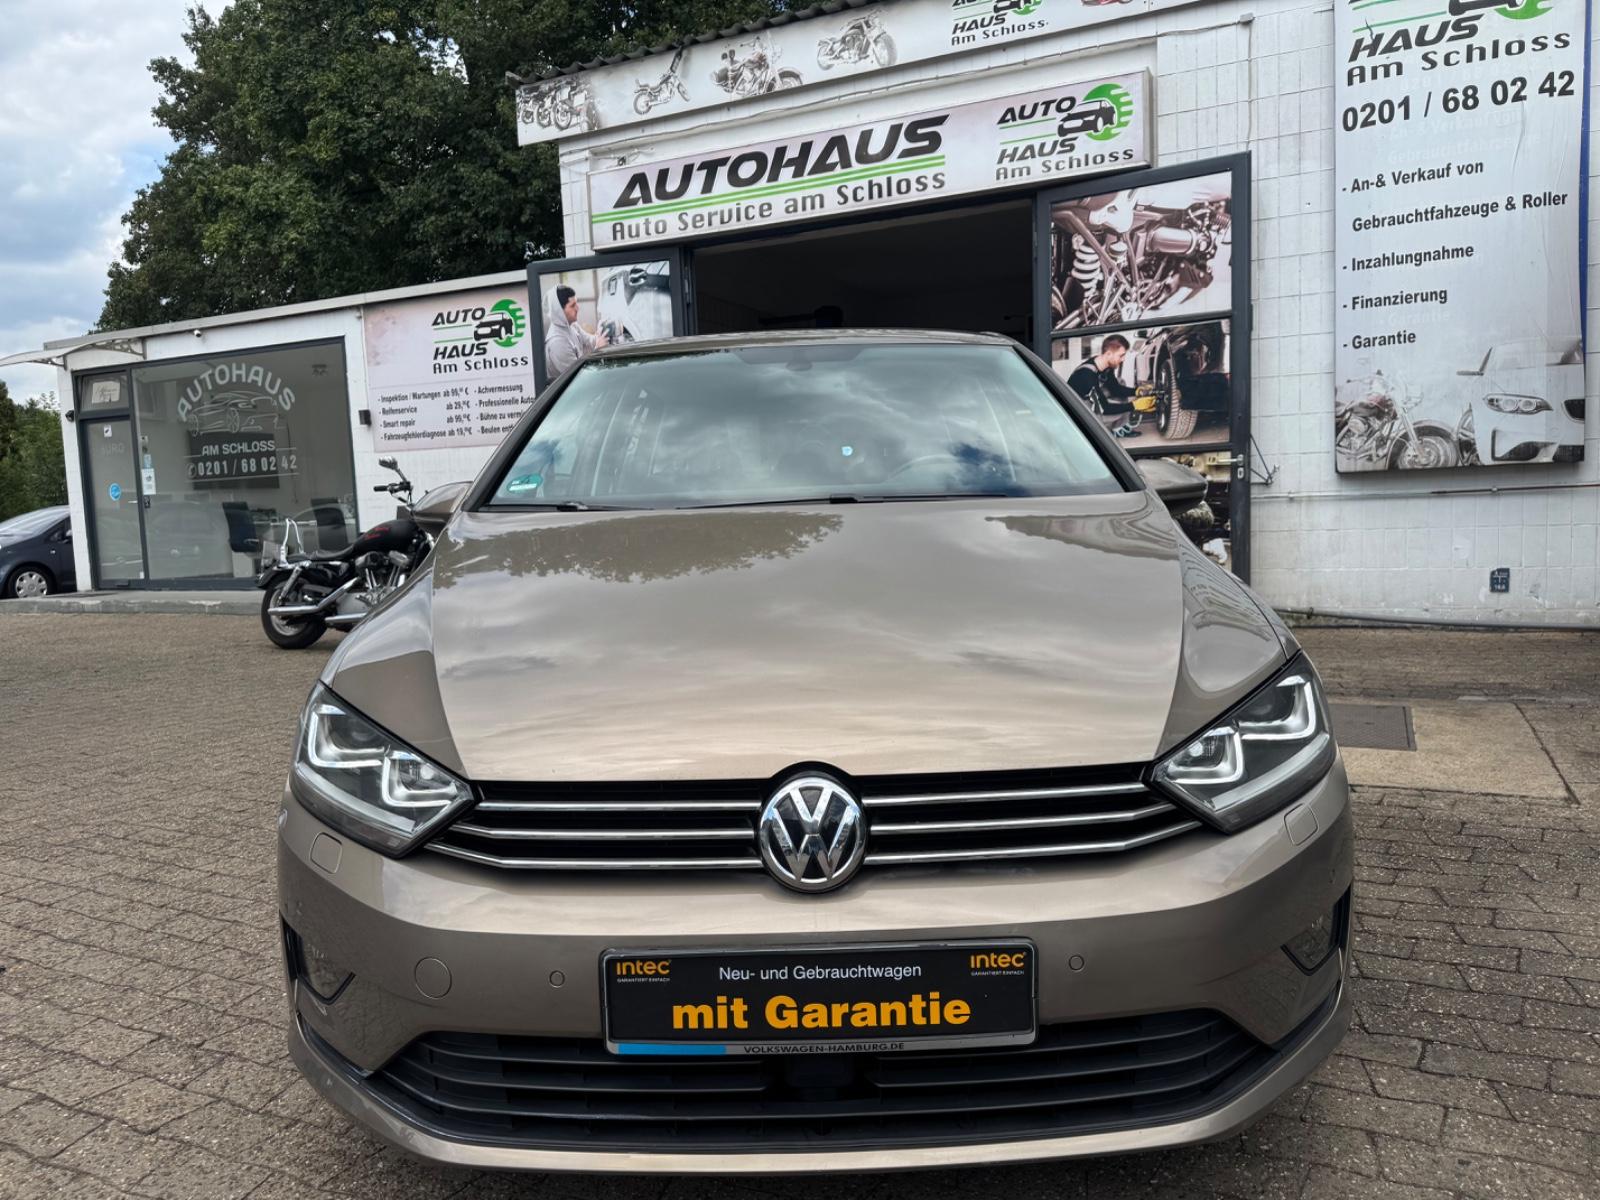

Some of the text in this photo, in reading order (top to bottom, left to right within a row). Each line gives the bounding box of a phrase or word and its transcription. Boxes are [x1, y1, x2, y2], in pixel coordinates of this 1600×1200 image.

[951, 20, 1045, 46] Am Schloss
[952, 13, 1007, 34] HAUS
[1348, 14, 1484, 63] HAUS
[1347, 33, 1570, 87] Am Schloss
[997, 96, 1076, 125] AUTO
[1342, 95, 1410, 132] 0201
[1424, 91, 1432, 118] /
[1442, 85, 1479, 113] 68
[1490, 77, 1527, 105] 02
[1538, 70, 1575, 98] 42
[613, 115, 950, 208] AUTOHAUS
[997, 137, 1079, 165] HAUS
[995, 149, 1134, 181] Am Schloss
[1391, 163, 1452, 186] Verkauf
[1457, 161, 1484, 176] von
[612, 172, 945, 241] Auto Service am Schloss
[1504, 196, 1516, 211] &
[1522, 191, 1568, 209] Roller
[1351, 245, 1474, 271] Inzahlungnahme
[1351, 288, 1448, 310] Finanzierung
[432, 307, 486, 326] AUTO
[433, 342, 489, 361] HAUS
[1352, 330, 1416, 350] Garantie
[433, 356, 528, 374] Am Schloss
[178, 362, 296, 422] AUTOHAUS
[202, 440, 275, 456] AM SCHLOSS
[198, 460, 228, 476] 0201
[241, 458, 257, 473] 68
[261, 456, 276, 471] 02
[281, 455, 297, 470] 42
[616, 960, 671, 976] intec
[970, 952, 1026, 969] intec
[719, 964, 922, 981] Neu- und Gebrauchtwagen
[672, 991, 971, 1030] mit Garantie
[744, 1042, 905, 1054] VOLKSWAGEN-HAMBURG.DE
